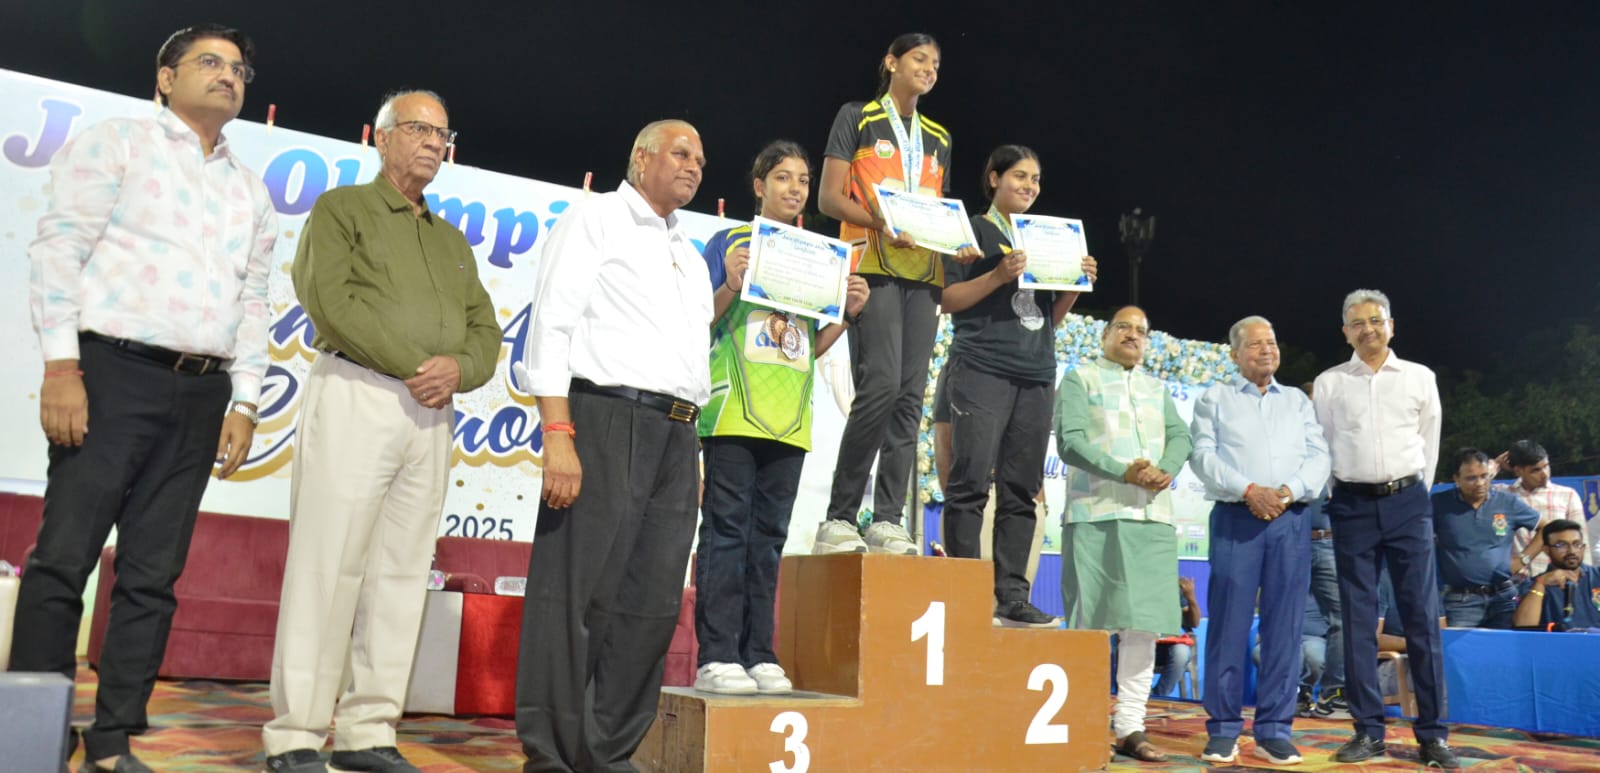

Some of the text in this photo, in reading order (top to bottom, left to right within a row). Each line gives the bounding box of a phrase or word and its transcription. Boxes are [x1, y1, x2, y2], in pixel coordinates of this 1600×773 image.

[445, 514, 513, 540] 2025
[911, 601, 945, 686] 1
[1025, 663, 1069, 744] 2
[769, 711, 811, 773] 3
